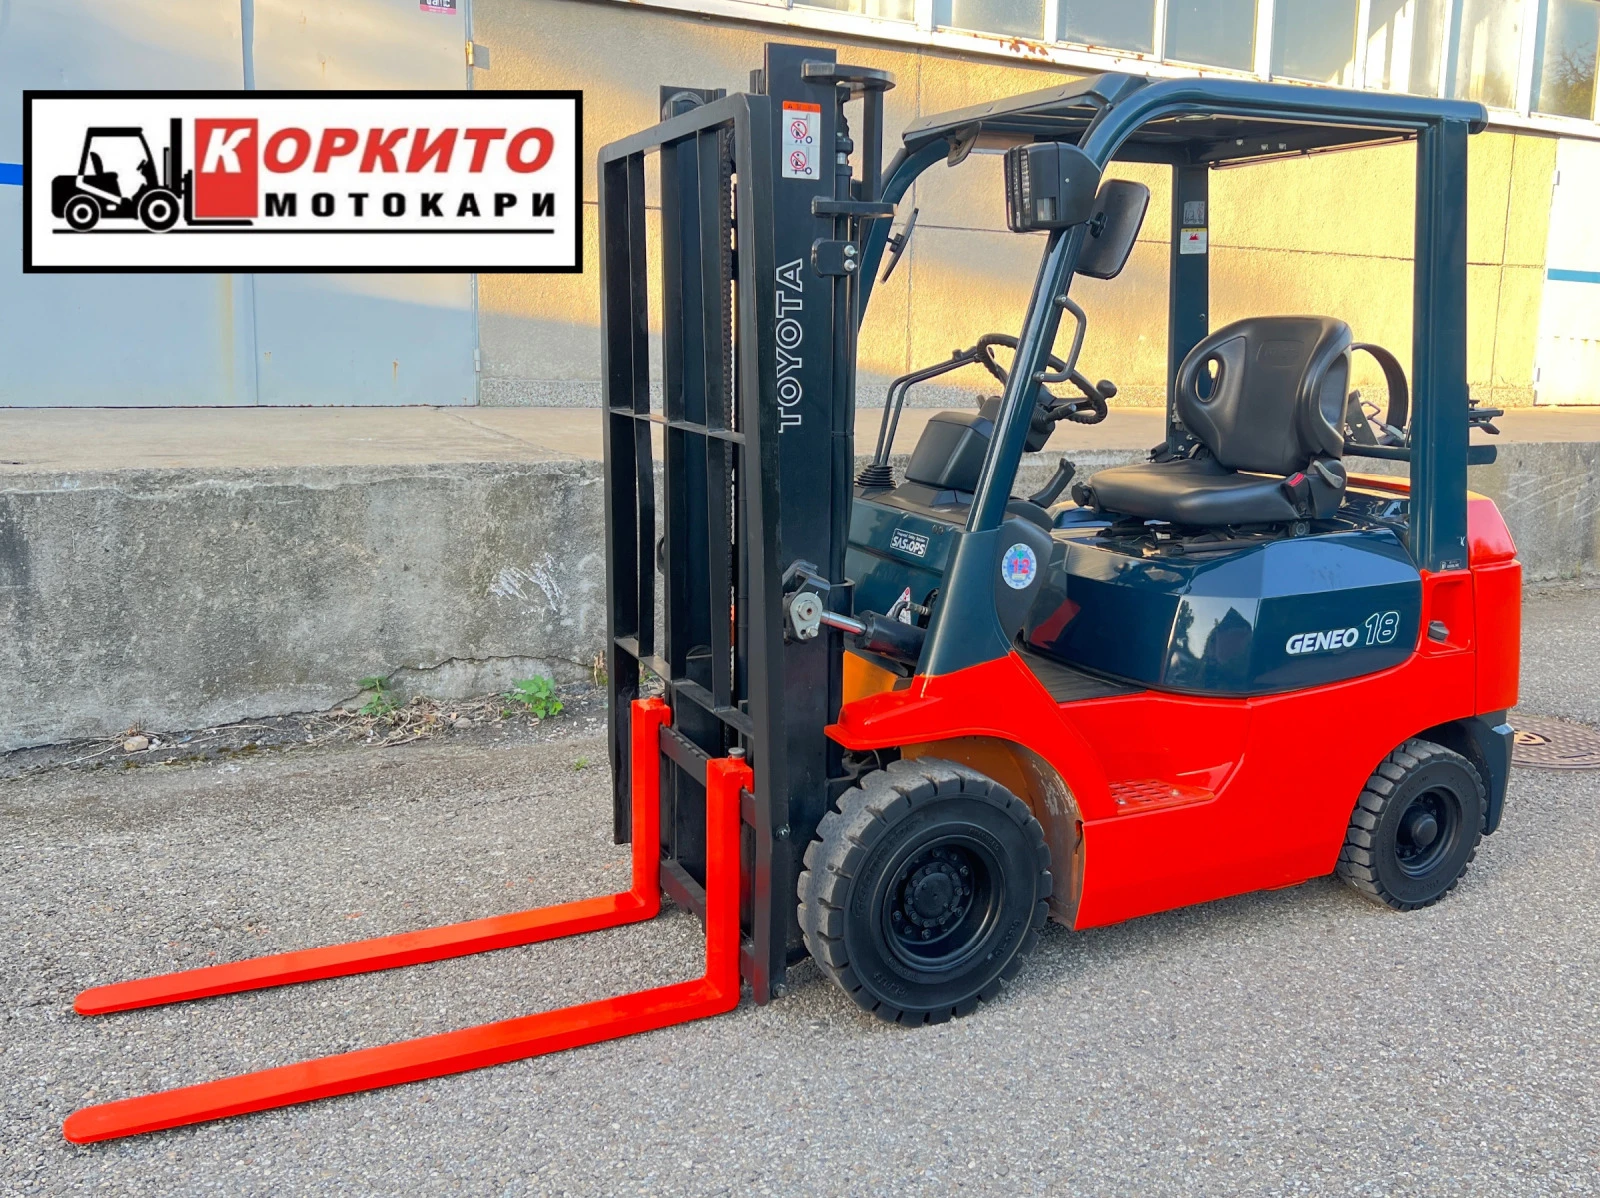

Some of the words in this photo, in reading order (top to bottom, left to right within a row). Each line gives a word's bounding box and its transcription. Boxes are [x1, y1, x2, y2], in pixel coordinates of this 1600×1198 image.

[776, 258, 803, 433] TOYOTA
[1012, 558, 1030, 574] 12
[1285, 627, 1359, 655] GENEO
[1365, 611, 1400, 645] 18
